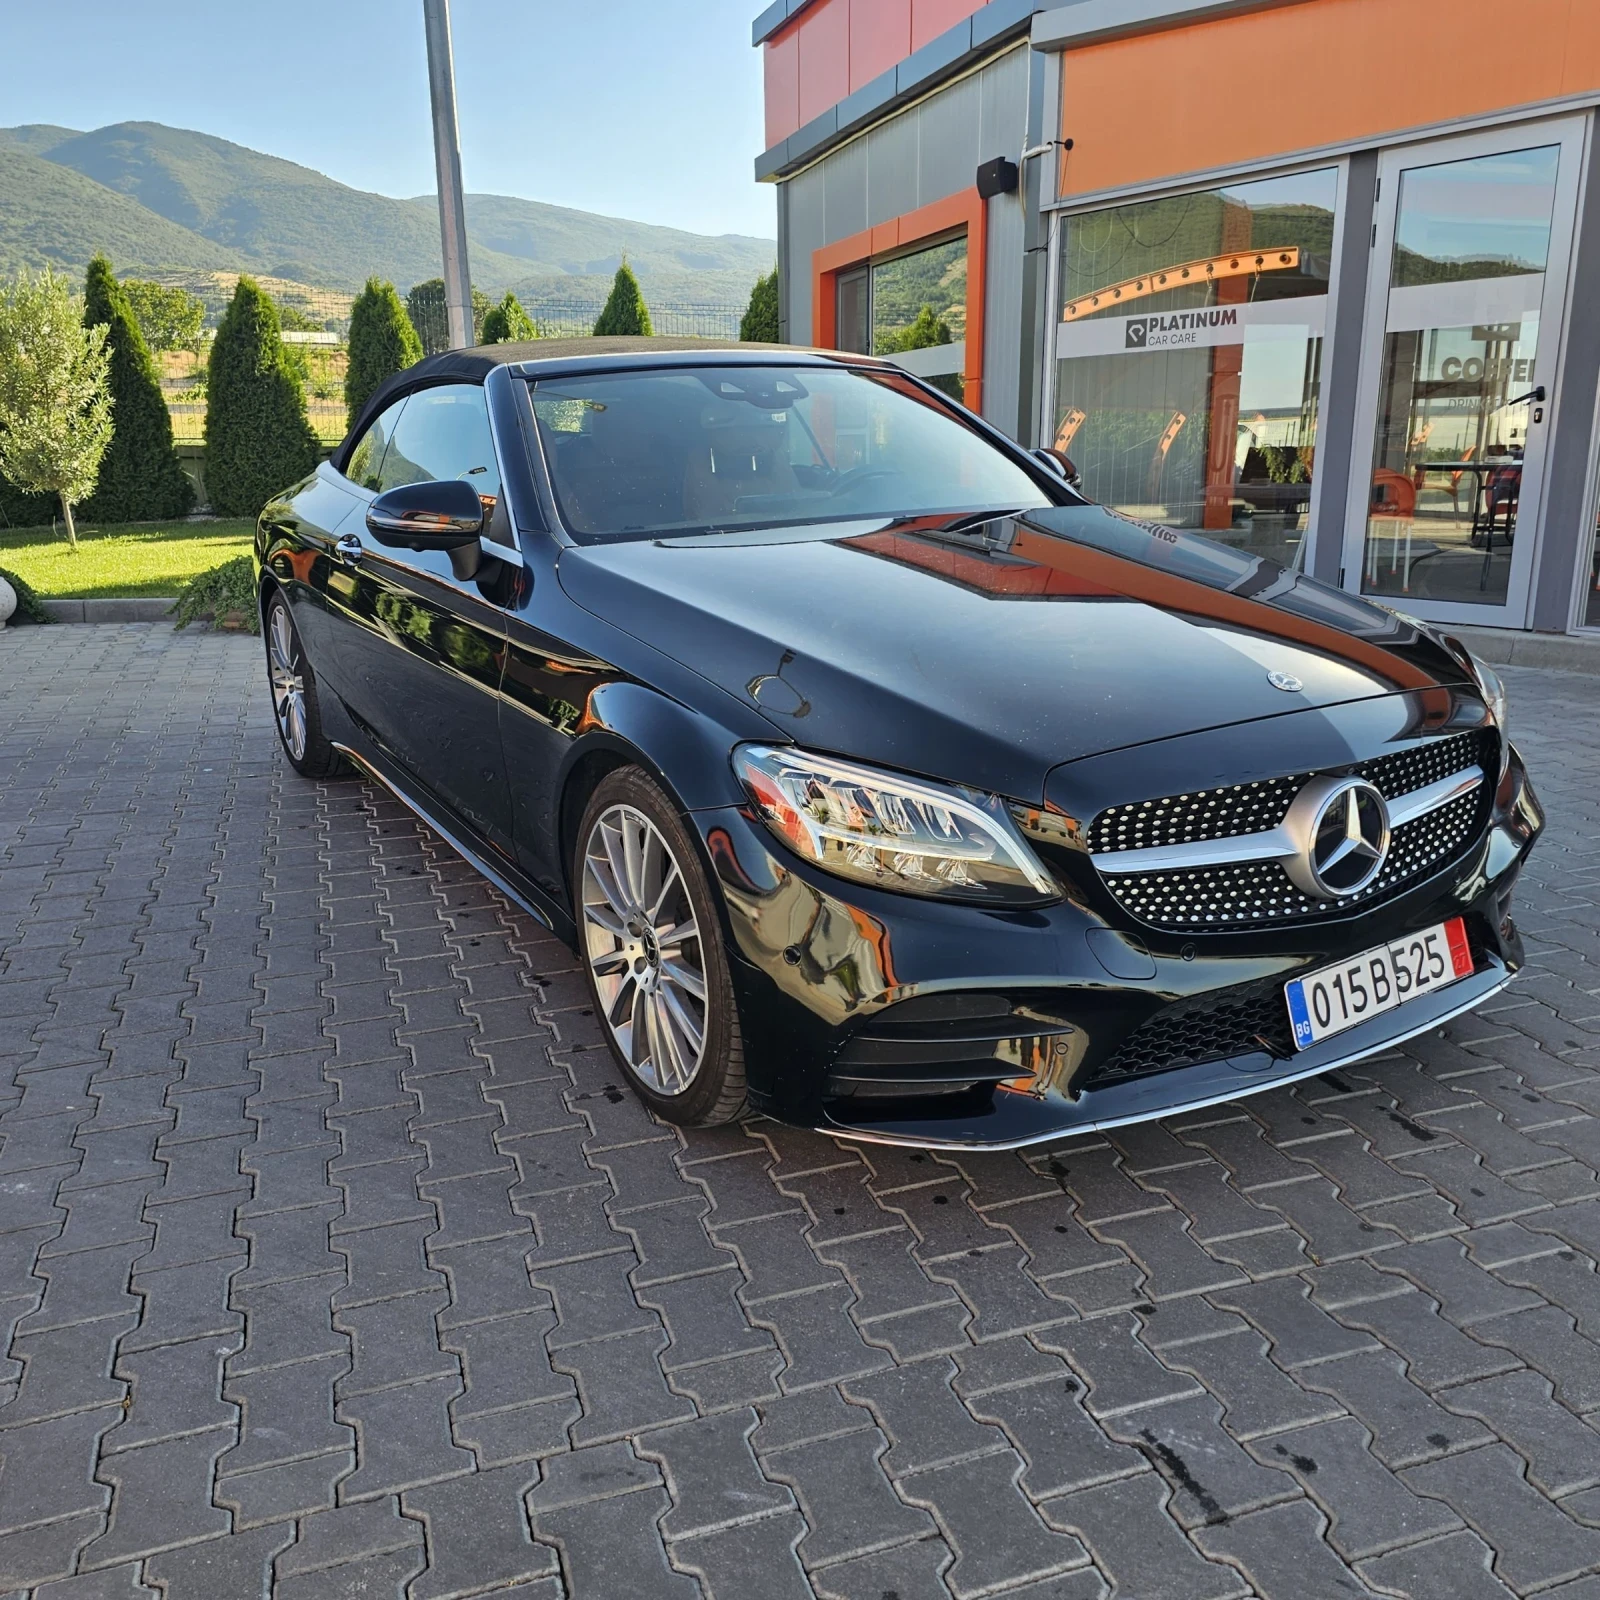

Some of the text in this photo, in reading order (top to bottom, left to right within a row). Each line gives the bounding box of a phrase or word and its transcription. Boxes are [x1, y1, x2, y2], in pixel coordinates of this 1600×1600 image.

[1149, 309, 1237, 332] PLATINUM
[1148, 332, 1197, 346] CAR CARE
[1295, 1022, 1311, 1038] BG
